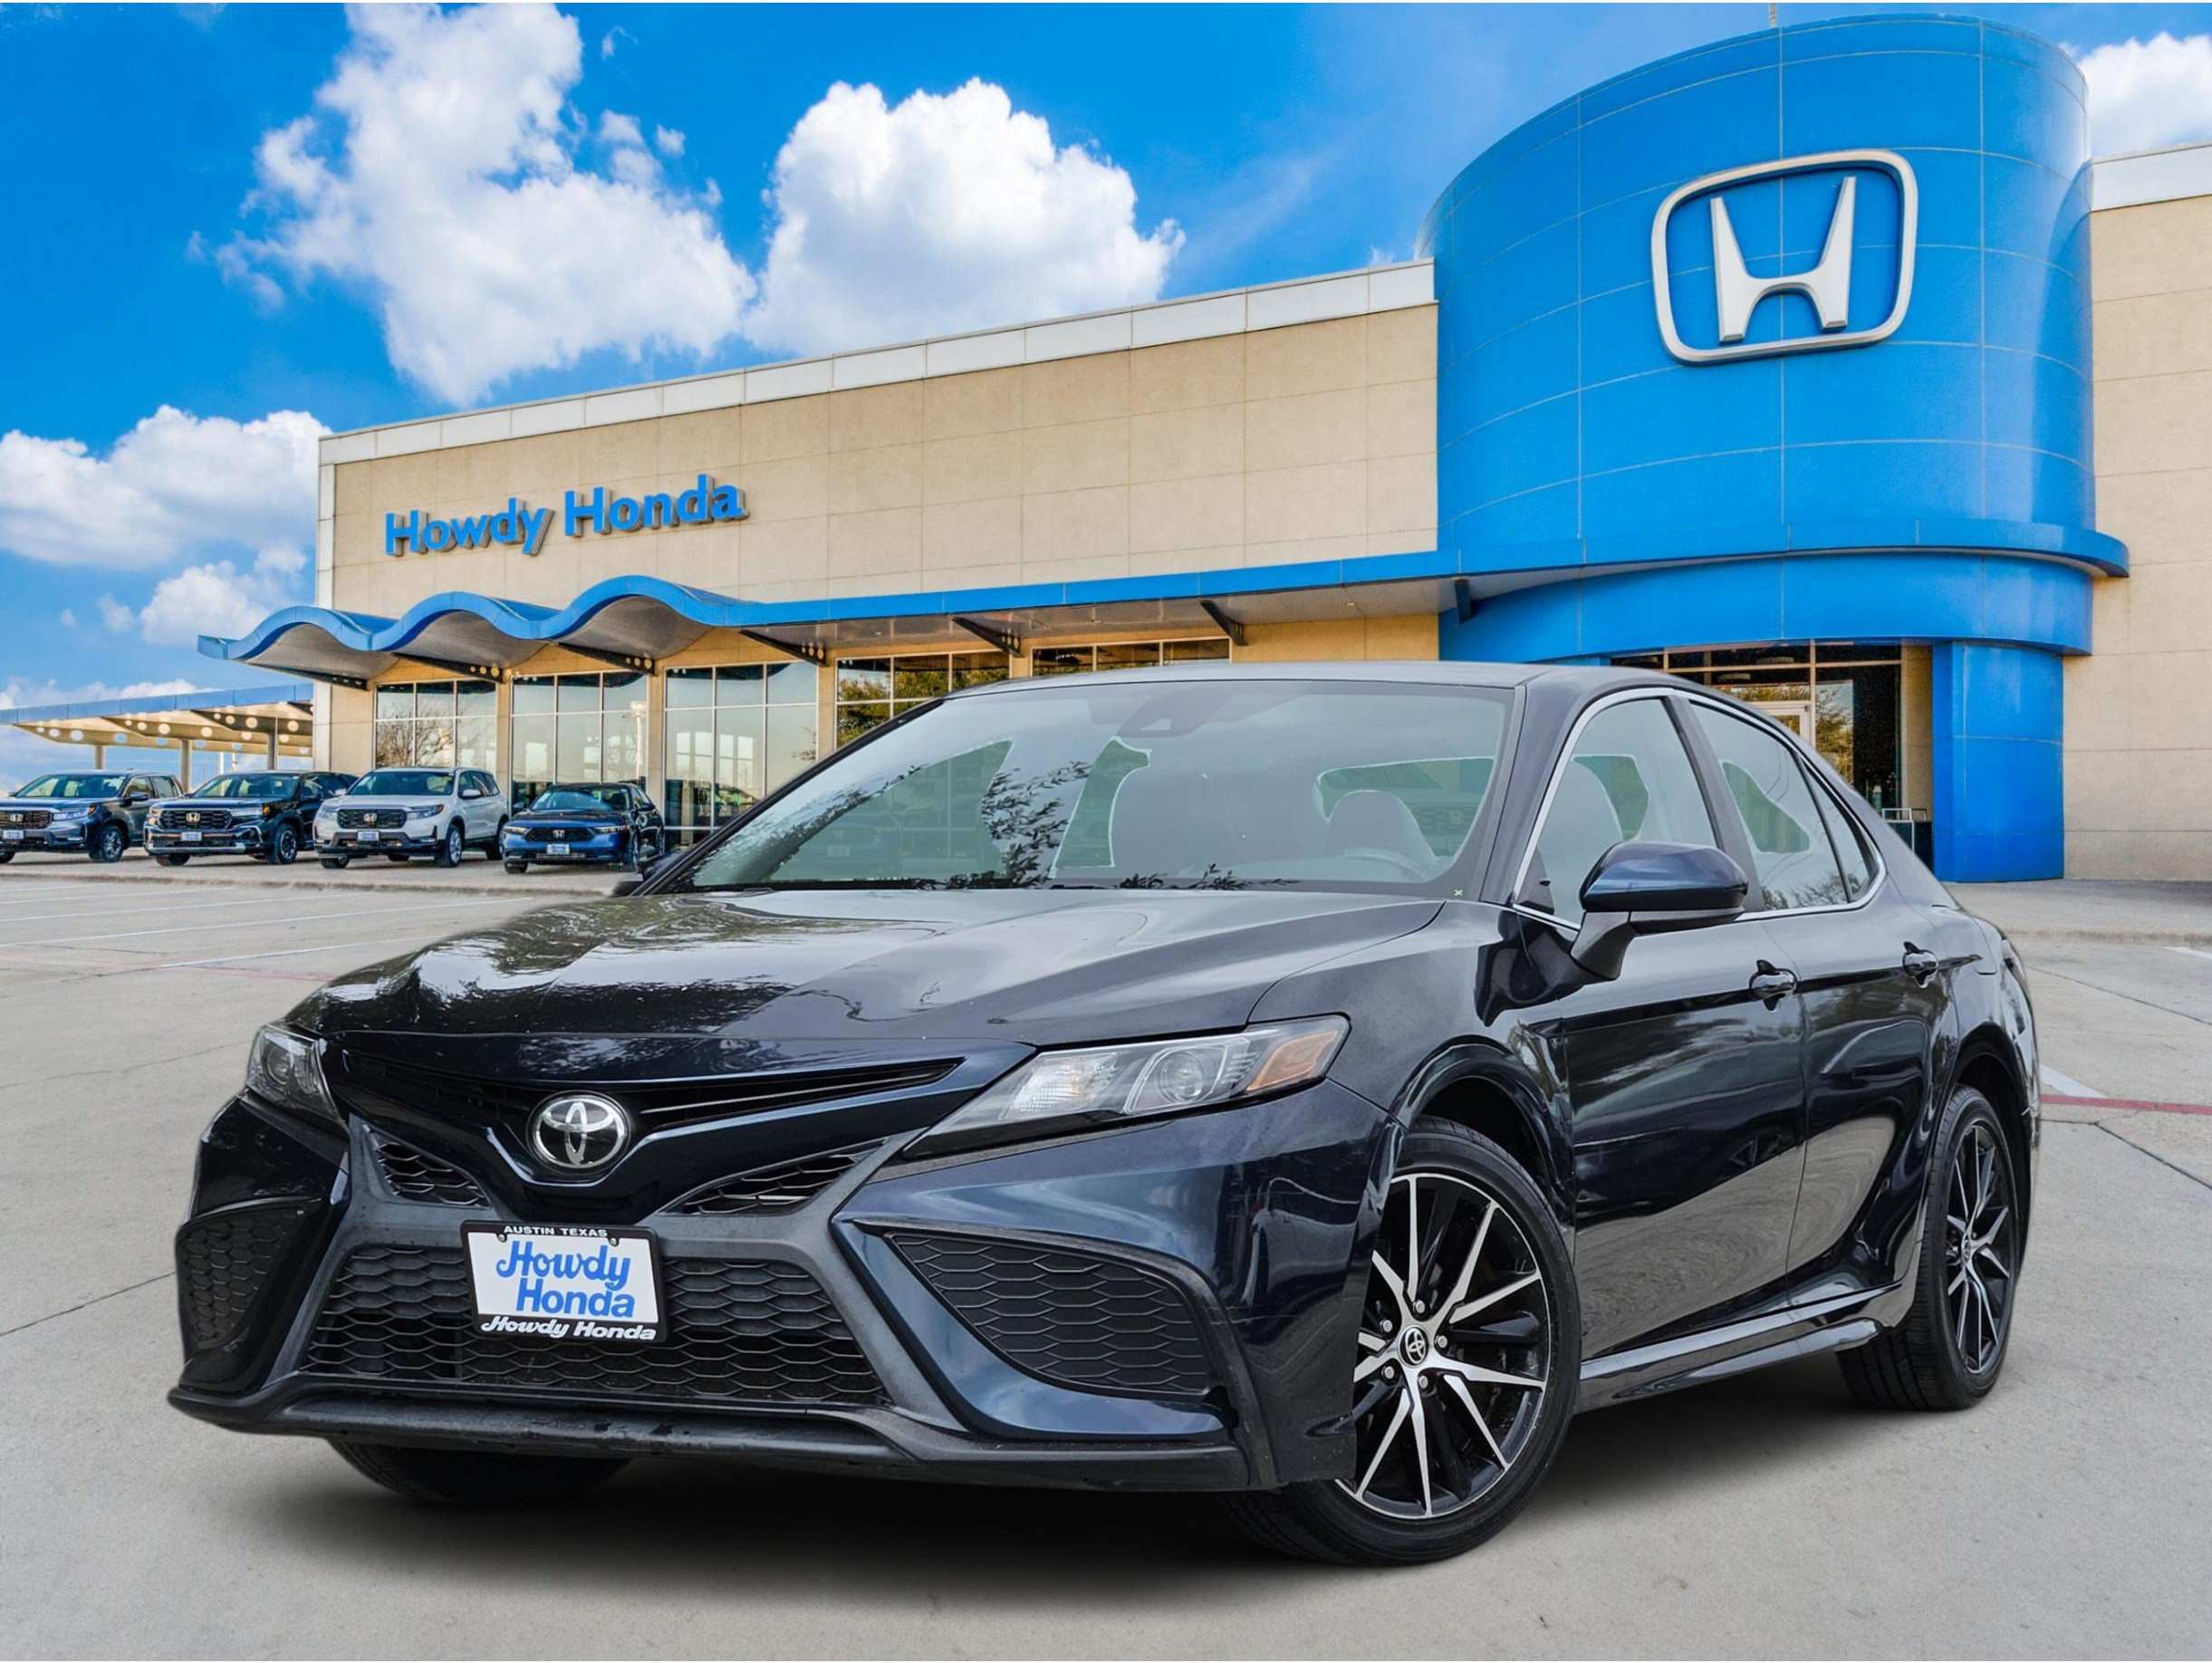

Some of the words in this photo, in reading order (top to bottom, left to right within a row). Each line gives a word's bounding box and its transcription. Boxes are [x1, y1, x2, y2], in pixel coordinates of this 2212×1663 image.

[385, 496, 554, 556] Howdy
[564, 473, 749, 538] Honda
[503, 1225, 555, 1235] AUSTIN
[560, 1227, 609, 1237] TEXAS
[495, 1240, 631, 1291] Howdy
[515, 1278, 636, 1318] Honda
[480, 1315, 569, 1339] Howdy
[572, 1321, 658, 1341] Honda
